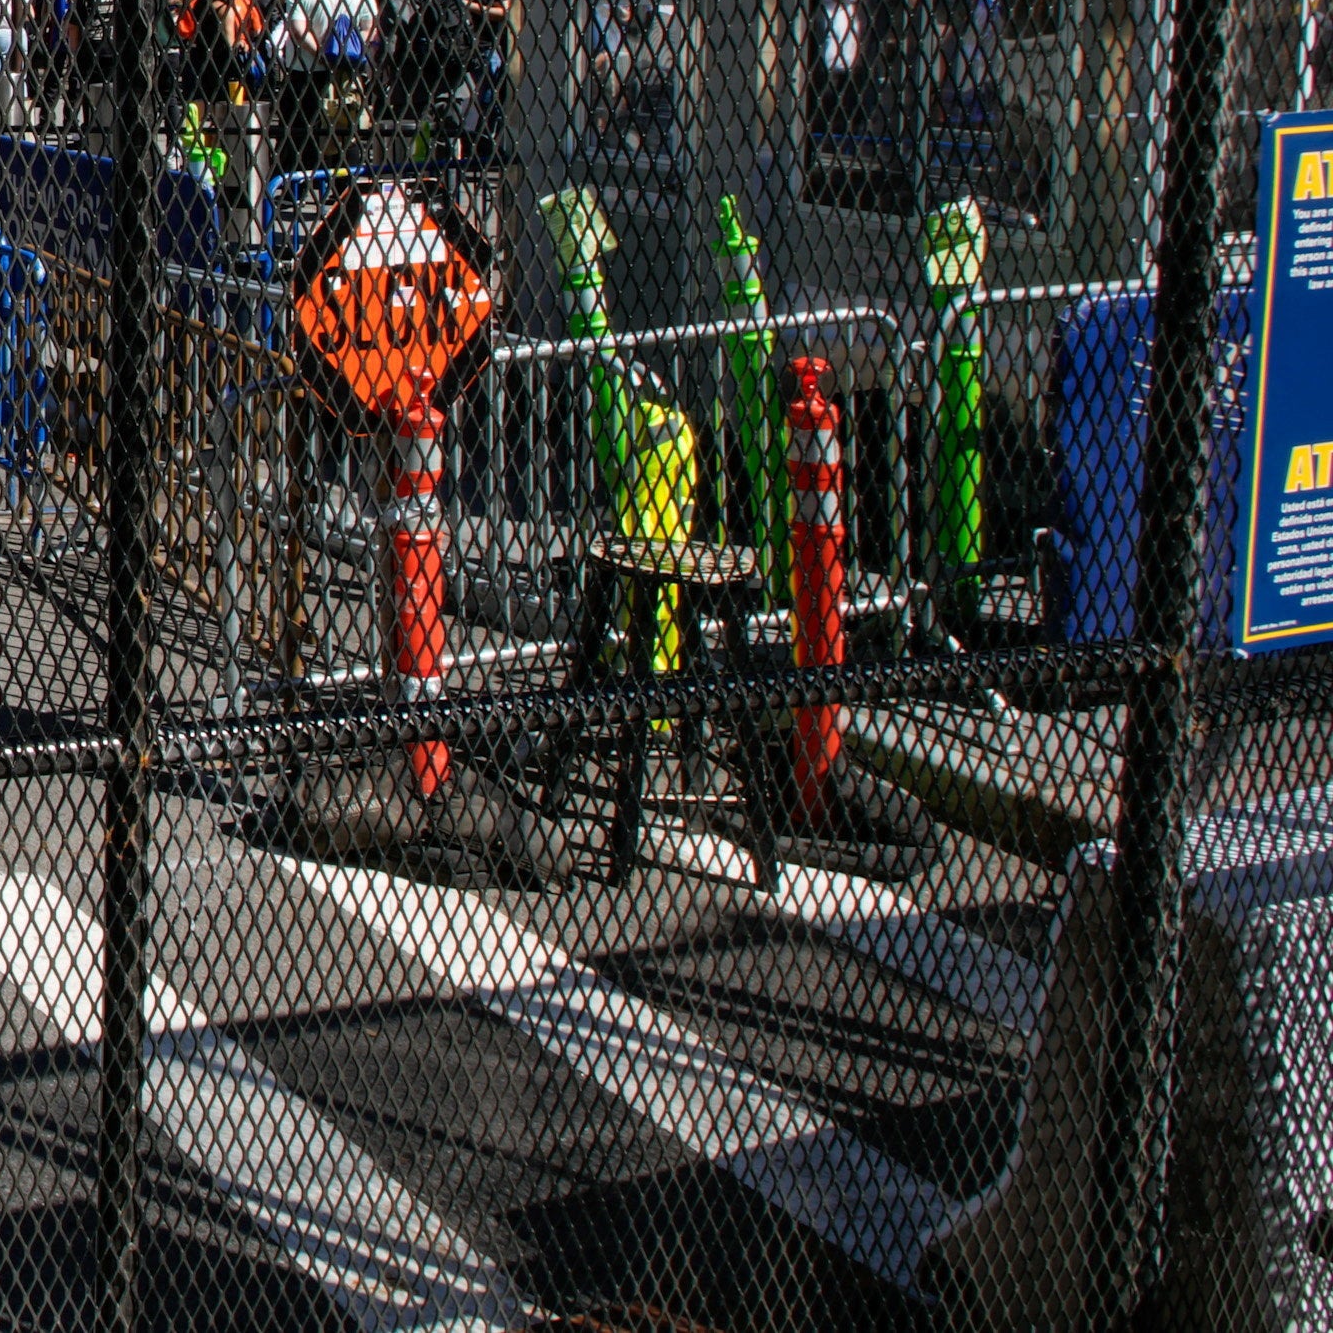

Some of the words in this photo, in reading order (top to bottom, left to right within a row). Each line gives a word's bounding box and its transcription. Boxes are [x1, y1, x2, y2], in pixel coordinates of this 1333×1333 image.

[1292, 208, 1311, 220] You
[1311, 208, 1328, 218] are
[1298, 220, 1333, 234] defined
[1294, 236, 1333, 248] entering
[1293, 251, 1326, 265] person
[1289, 266, 1308, 278] this
[1308, 265, 1330, 276] area
[1308, 278, 1325, 290] law
[1284, 441, 1333, 494] AT
[1281, 499, 1306, 514] Usted
[1271, 529, 1306, 543] Estados
[1300, 538, 1325, 552] usted
[1267, 552, 1329, 573] personalmente
[1273, 567, 1314, 584] autoridad
[1304, 582, 1317, 593] en
